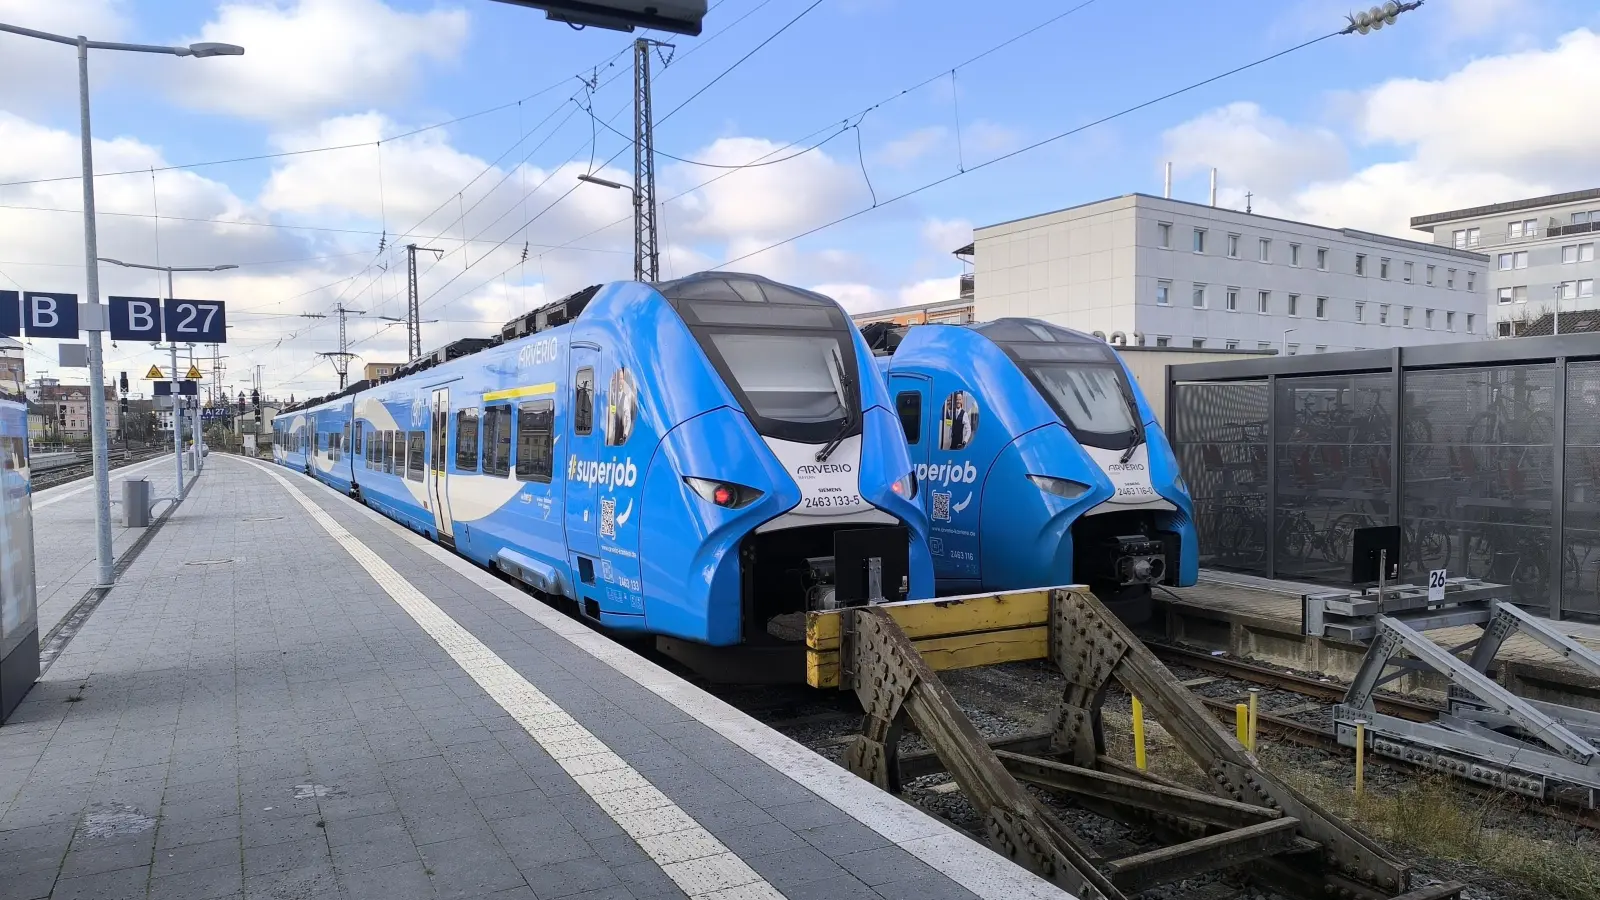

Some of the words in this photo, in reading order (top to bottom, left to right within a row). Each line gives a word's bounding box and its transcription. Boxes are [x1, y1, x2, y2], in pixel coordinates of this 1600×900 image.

[31, 296, 59, 328] B
[127, 300, 154, 332] B
[176, 303, 219, 333] 27
[518, 336, 558, 368] ARVERIO
[568, 454, 637, 492] #superjob
[797, 463, 852, 475] ARVERIO
[1108, 463, 1145, 472] ARVERIO
[1117, 487, 1136, 496] 2463
[1136, 486, 1153, 495] 116-0
[804, 496, 831, 508] 2463
[832, 494, 860, 506] 133-5
[965, 552, 974, 561] 116
[1430, 570, 1445, 588] 26
